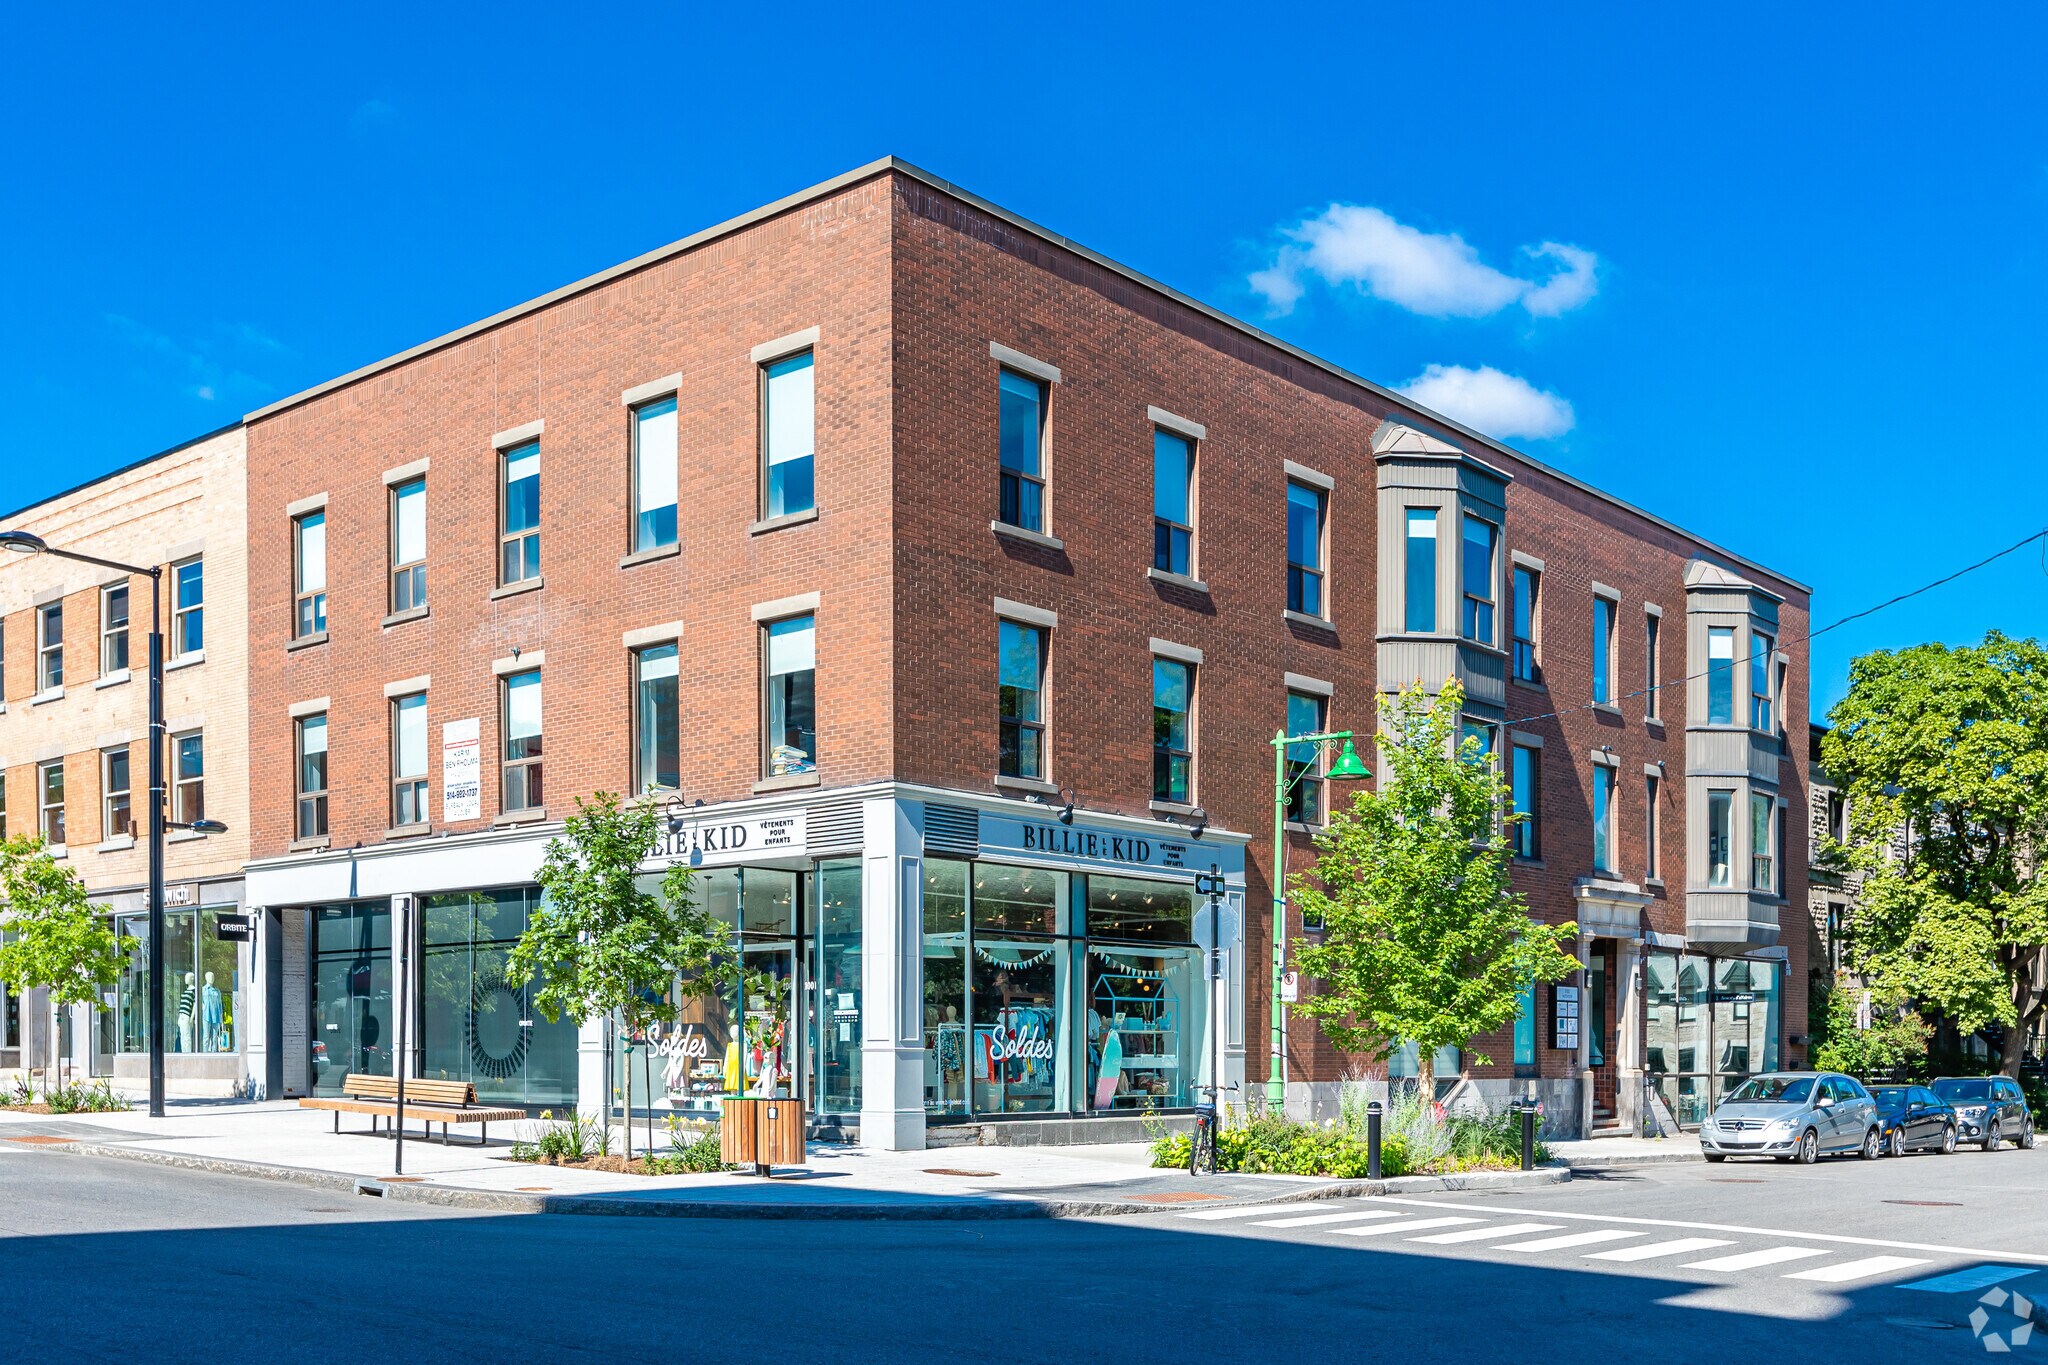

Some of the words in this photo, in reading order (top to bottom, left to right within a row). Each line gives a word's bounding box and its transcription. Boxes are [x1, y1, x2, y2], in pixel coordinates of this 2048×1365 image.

[760, 819, 794, 829] VÊTEMENTS
[703, 825, 747, 852] KID
[764, 836, 791, 845] ENFANTS
[1022, 825, 1098, 857] BILLIE
[1112, 837, 1150, 862] KID
[220, 923, 248, 932] ORBITE
[647, 1023, 707, 1059] Soldes
[989, 1024, 1053, 1060] Soldes
